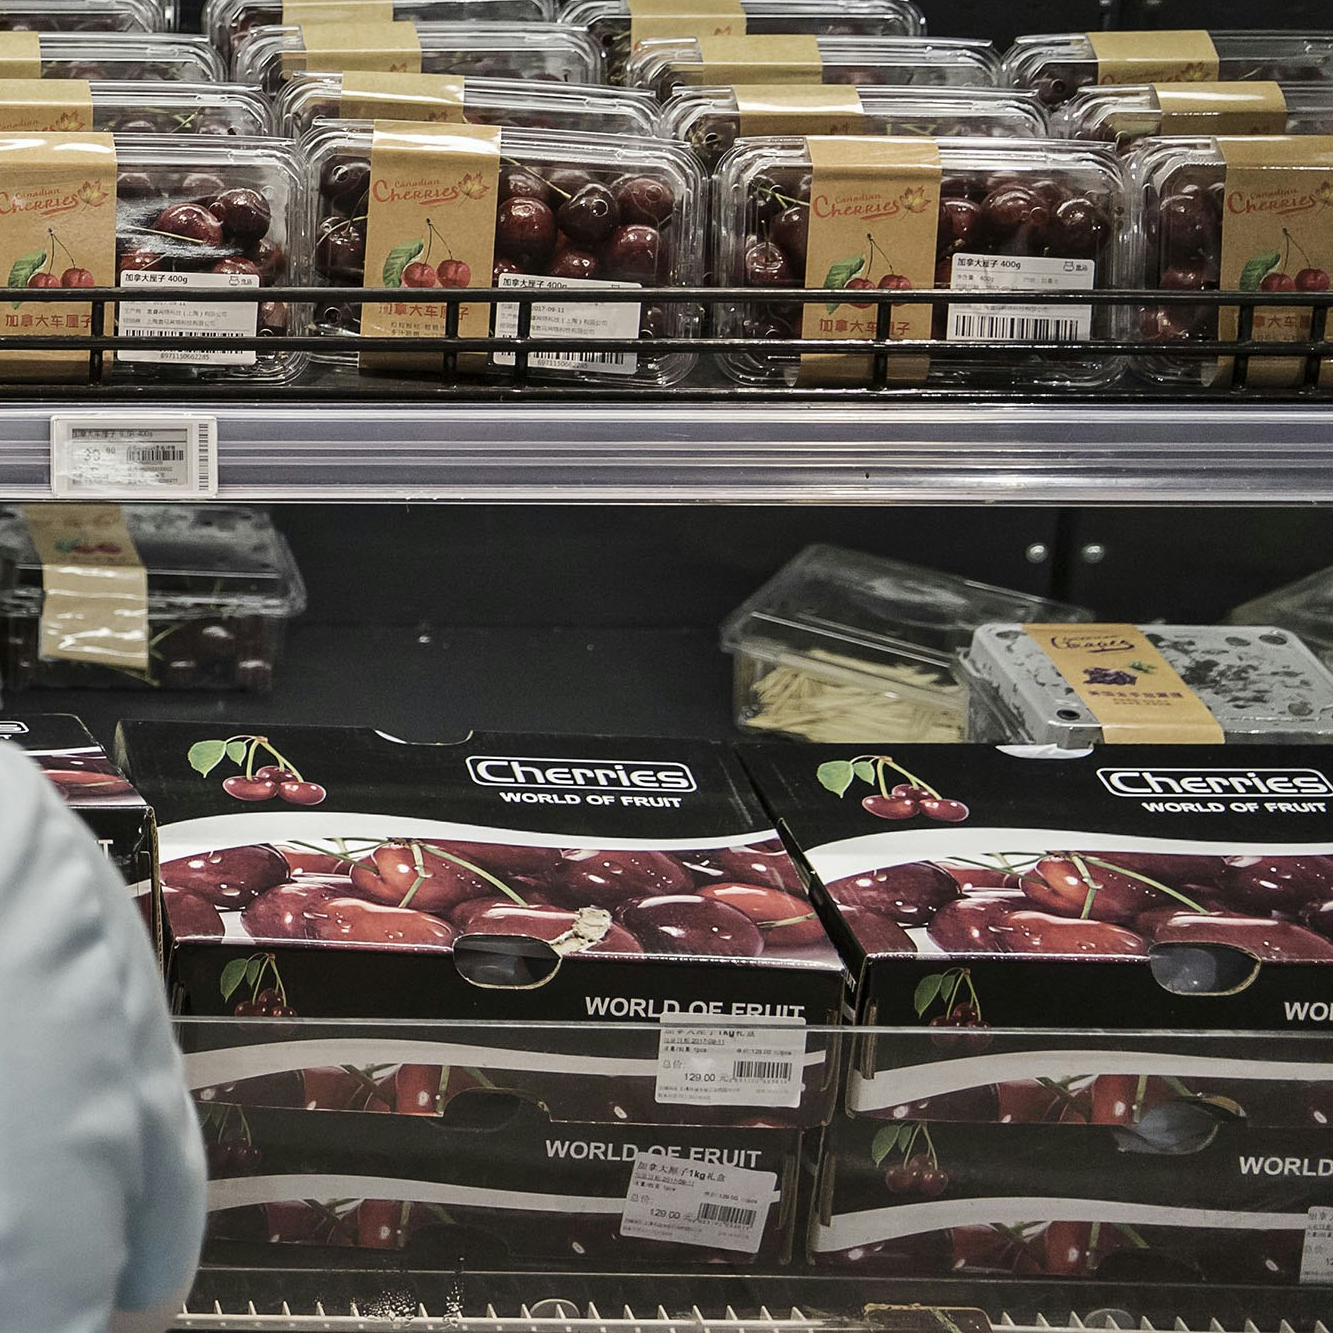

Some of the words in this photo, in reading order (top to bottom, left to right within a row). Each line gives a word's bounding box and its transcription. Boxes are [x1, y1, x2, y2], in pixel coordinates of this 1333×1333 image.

[394, 178, 440, 189] Canadian
[15, 188, 61, 201] Canadian
[373, 180, 459, 206] Cherries
[835, 194, 881, 203] Canadian
[813, 195, 900, 221] Cherries
[1227, 190, 1316, 215] Cherries
[1000, 259, 1021, 270] 400g
[125, 273, 166, 283] 加拿大厘子
[168, 275, 188, 284] 400g
[379, 303, 469, 321] 加拿大车子
[6, 314, 92, 328] 加拿大车厘子
[479, 761, 690, 791] Cherries
[1109, 771, 1330, 796] Cherries
[499, 792, 577, 807] WORLD
[587, 793, 616, 807] OF
[622, 794, 683, 809] FRUIT
[1141, 801, 1225, 814] WORLD
[1230, 801, 1261, 813] OF
[1264, 801, 1328, 814] FRUIT
[585, 997, 679, 1017] WORLD
[689, 1001, 723, 1014] OF
[732, 1003, 805, 1018] FRUIT
[684, 1073, 715, 1083] 129.00
[545, 1140, 638, 1162] WORLD
[690, 1148, 762, 1168] FRUIT
[1239, 1156, 1333, 1177] WORLD
[650, 1209, 681, 1219] 129.00
